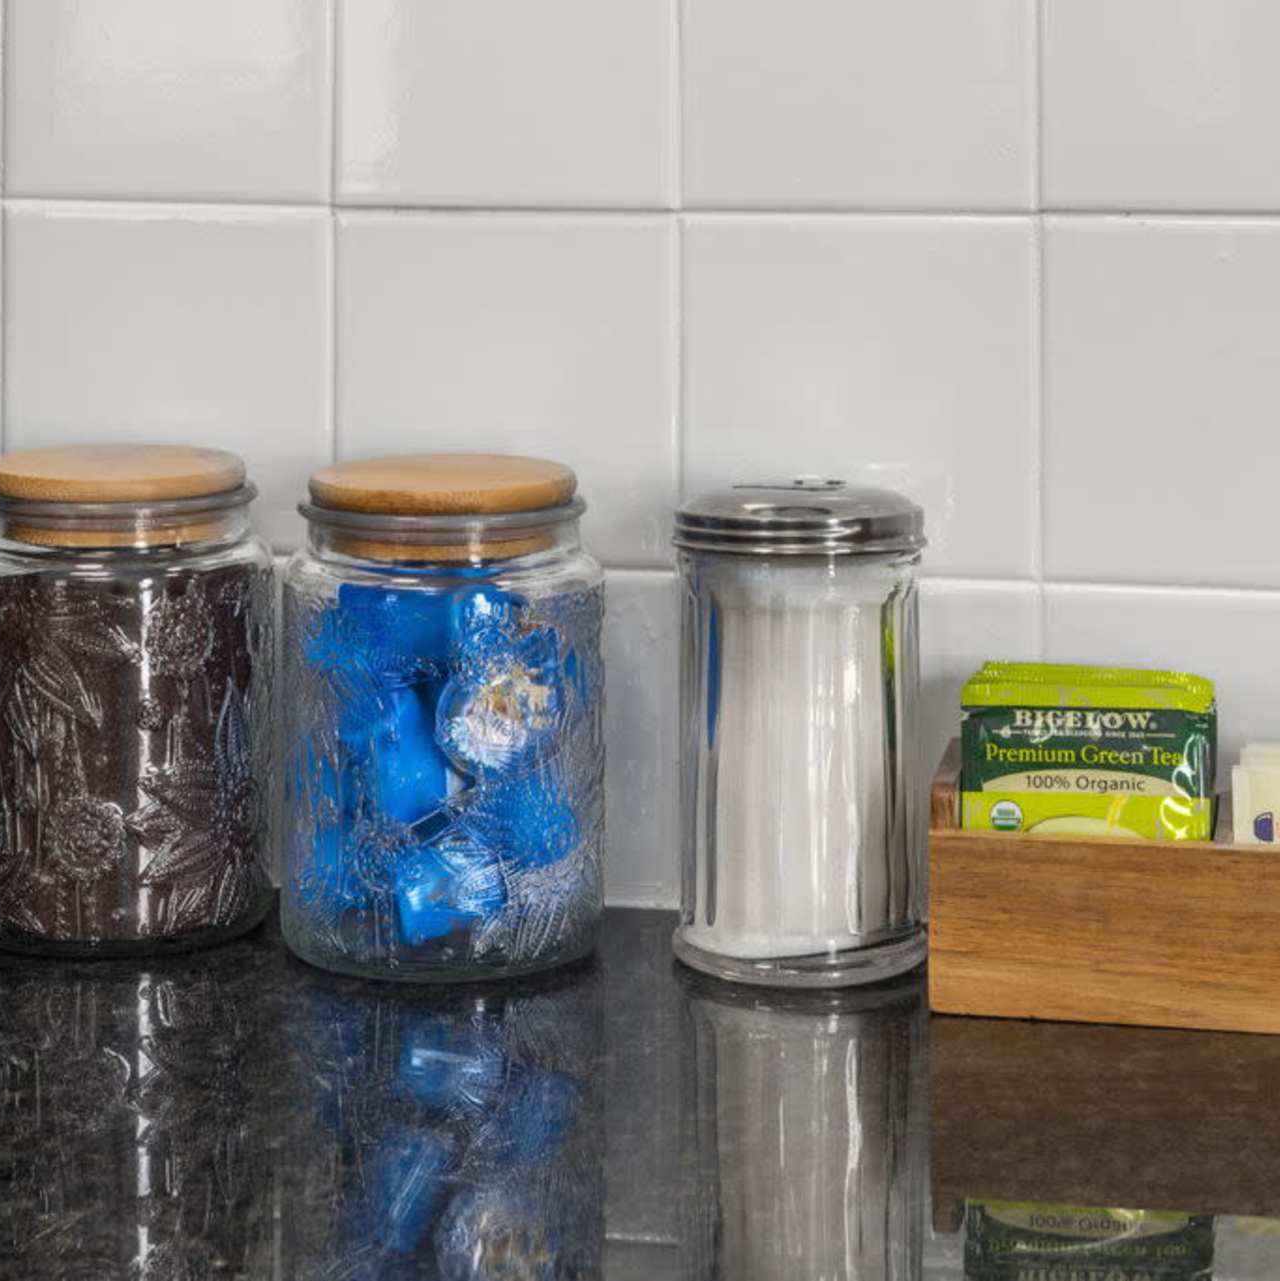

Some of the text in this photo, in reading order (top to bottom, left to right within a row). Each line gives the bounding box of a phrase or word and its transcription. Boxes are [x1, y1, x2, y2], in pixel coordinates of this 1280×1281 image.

[1013, 709, 1152, 731] BIGELOW
[985, 742, 1183, 766] Premium Green Tea
[1026, 774, 1145, 793] 100% Organic
